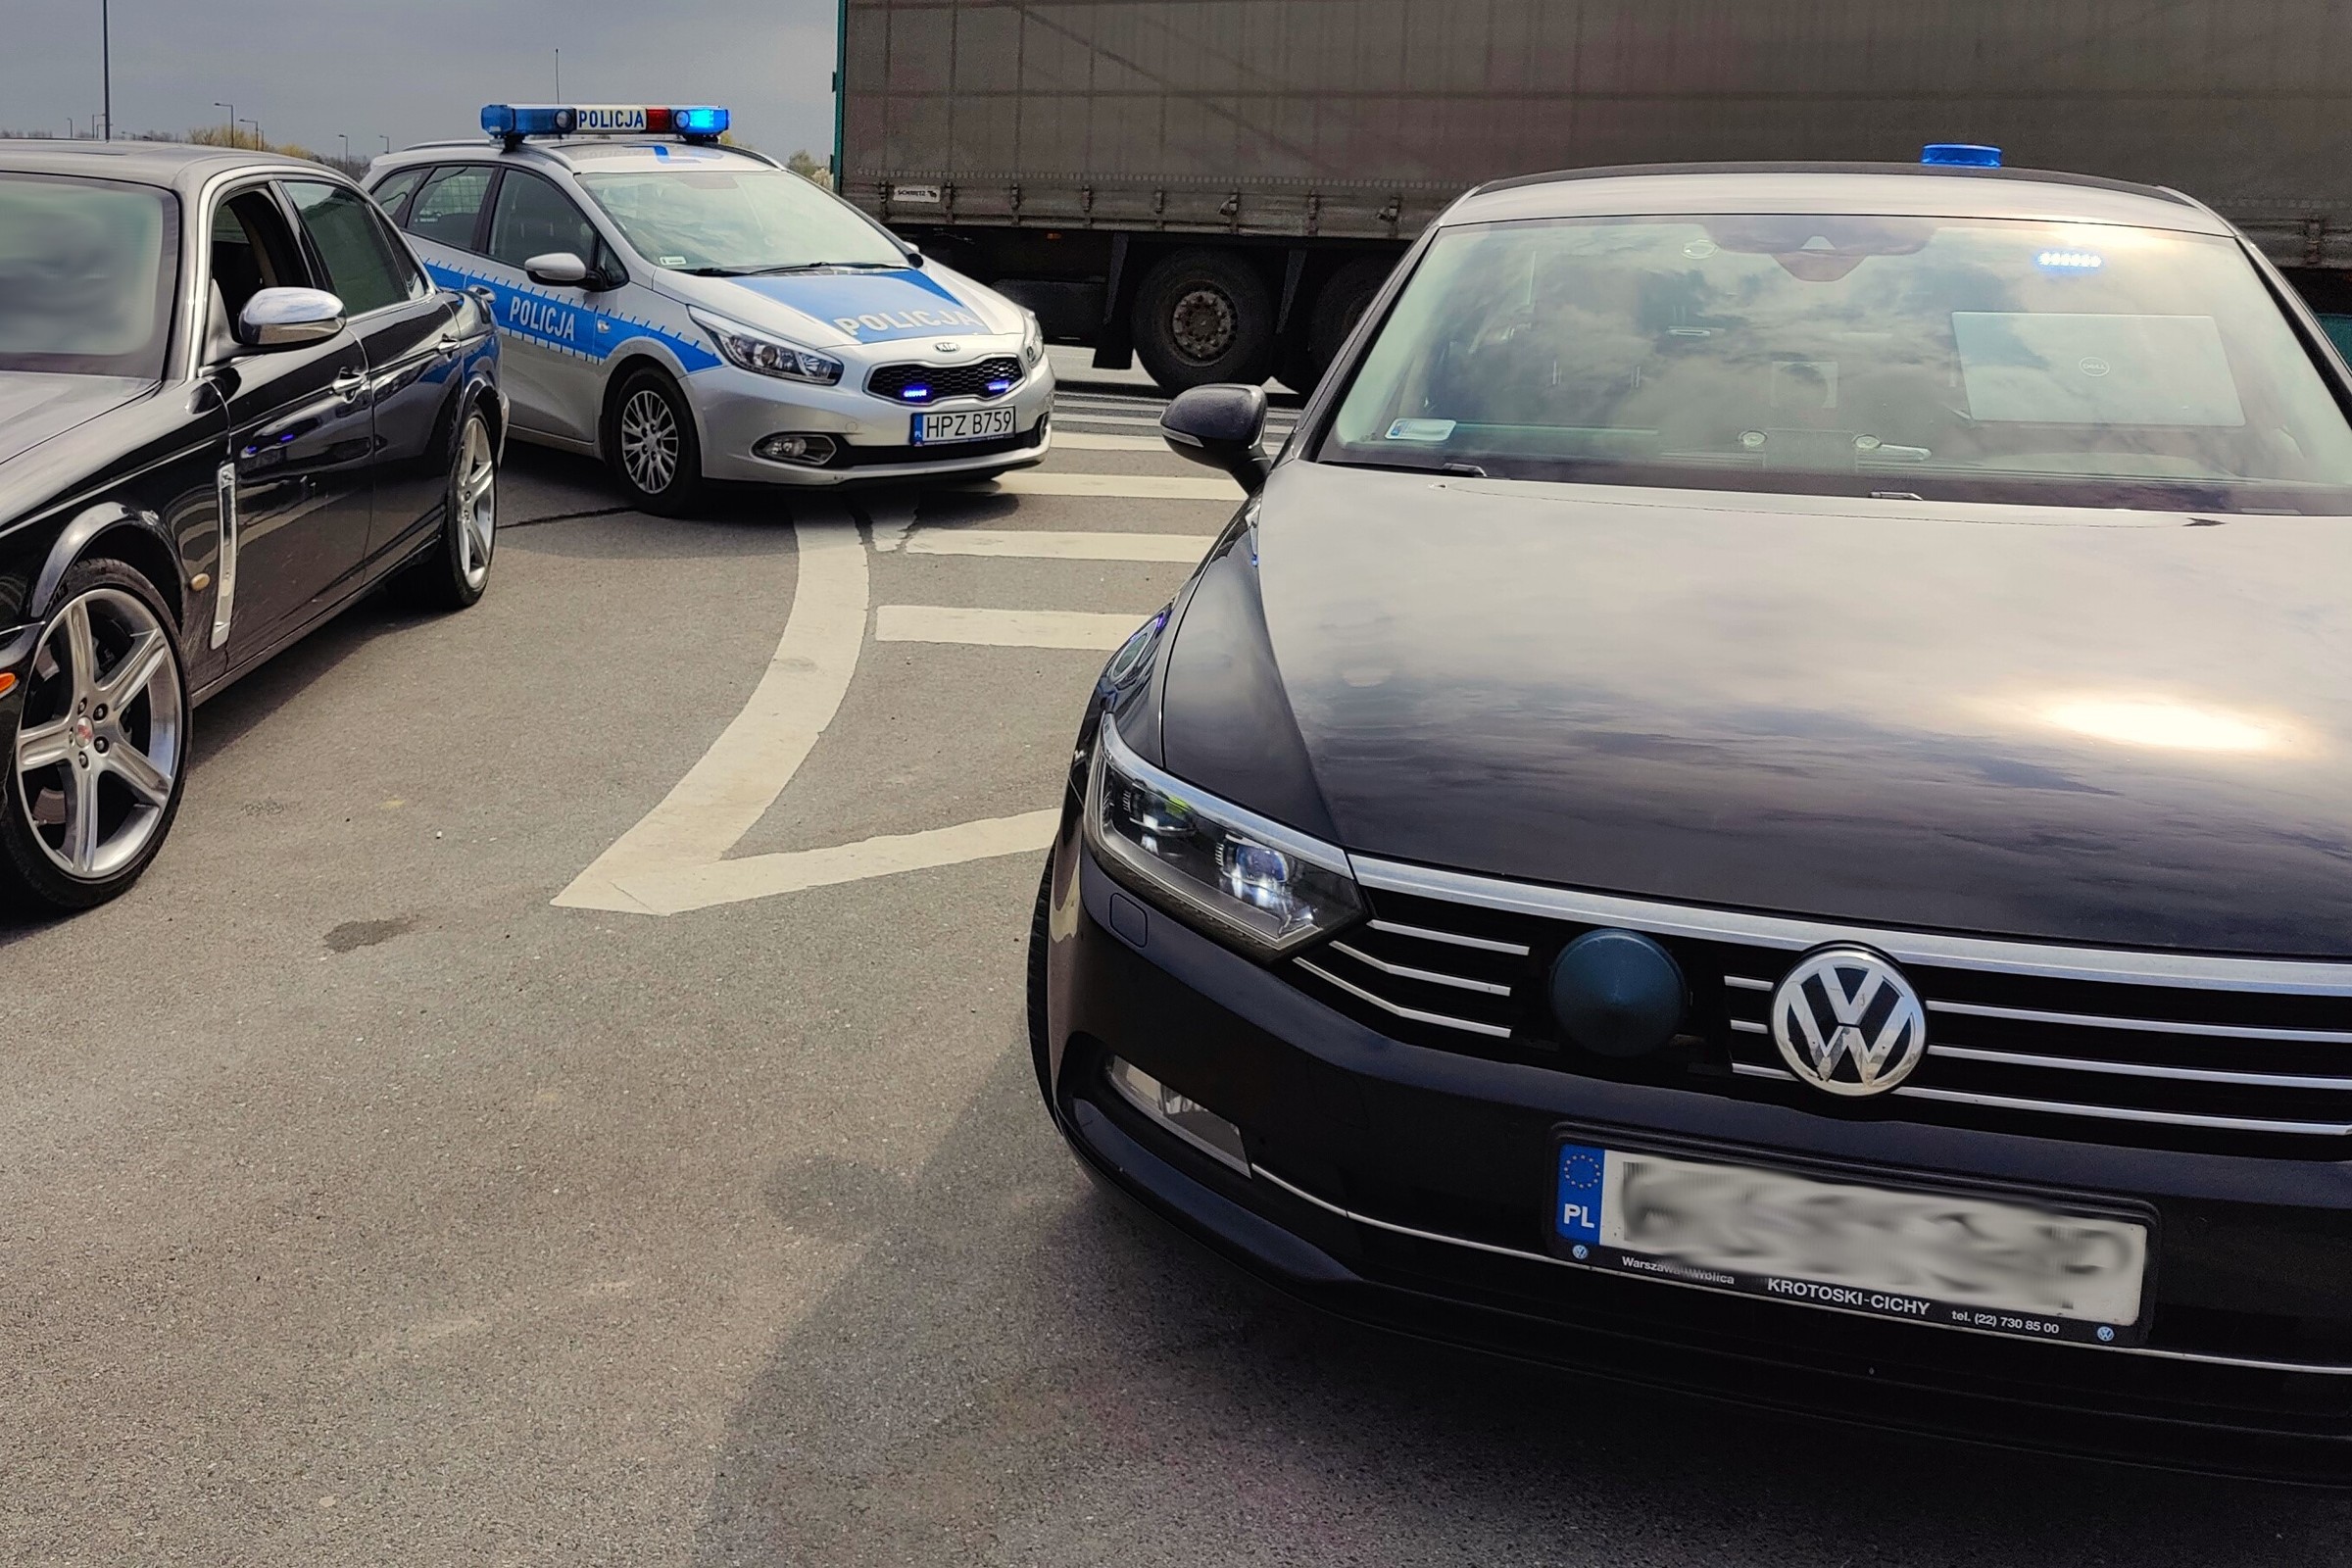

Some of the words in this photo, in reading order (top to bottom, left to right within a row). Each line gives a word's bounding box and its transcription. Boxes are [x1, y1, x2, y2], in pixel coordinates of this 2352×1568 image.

[578, 110, 644, 128] POLICJA
[510, 296, 575, 342] POLICJA
[833, 310, 985, 336] POLICJA
[926, 415, 967, 438] HPZ
[972, 411, 1012, 435] B759
[1563, 1202, 1595, 1229] PL
[1767, 1277, 1931, 1315] KROTOSKI-CICHY
[1951, 1310, 1972, 1322] tel.
[1974, 1313, 1997, 1327] (22)
[2000, 1317, 2023, 1329] 730
[2025, 1320, 2041, 1332] 85
[2043, 1323, 2060, 1334] 00
